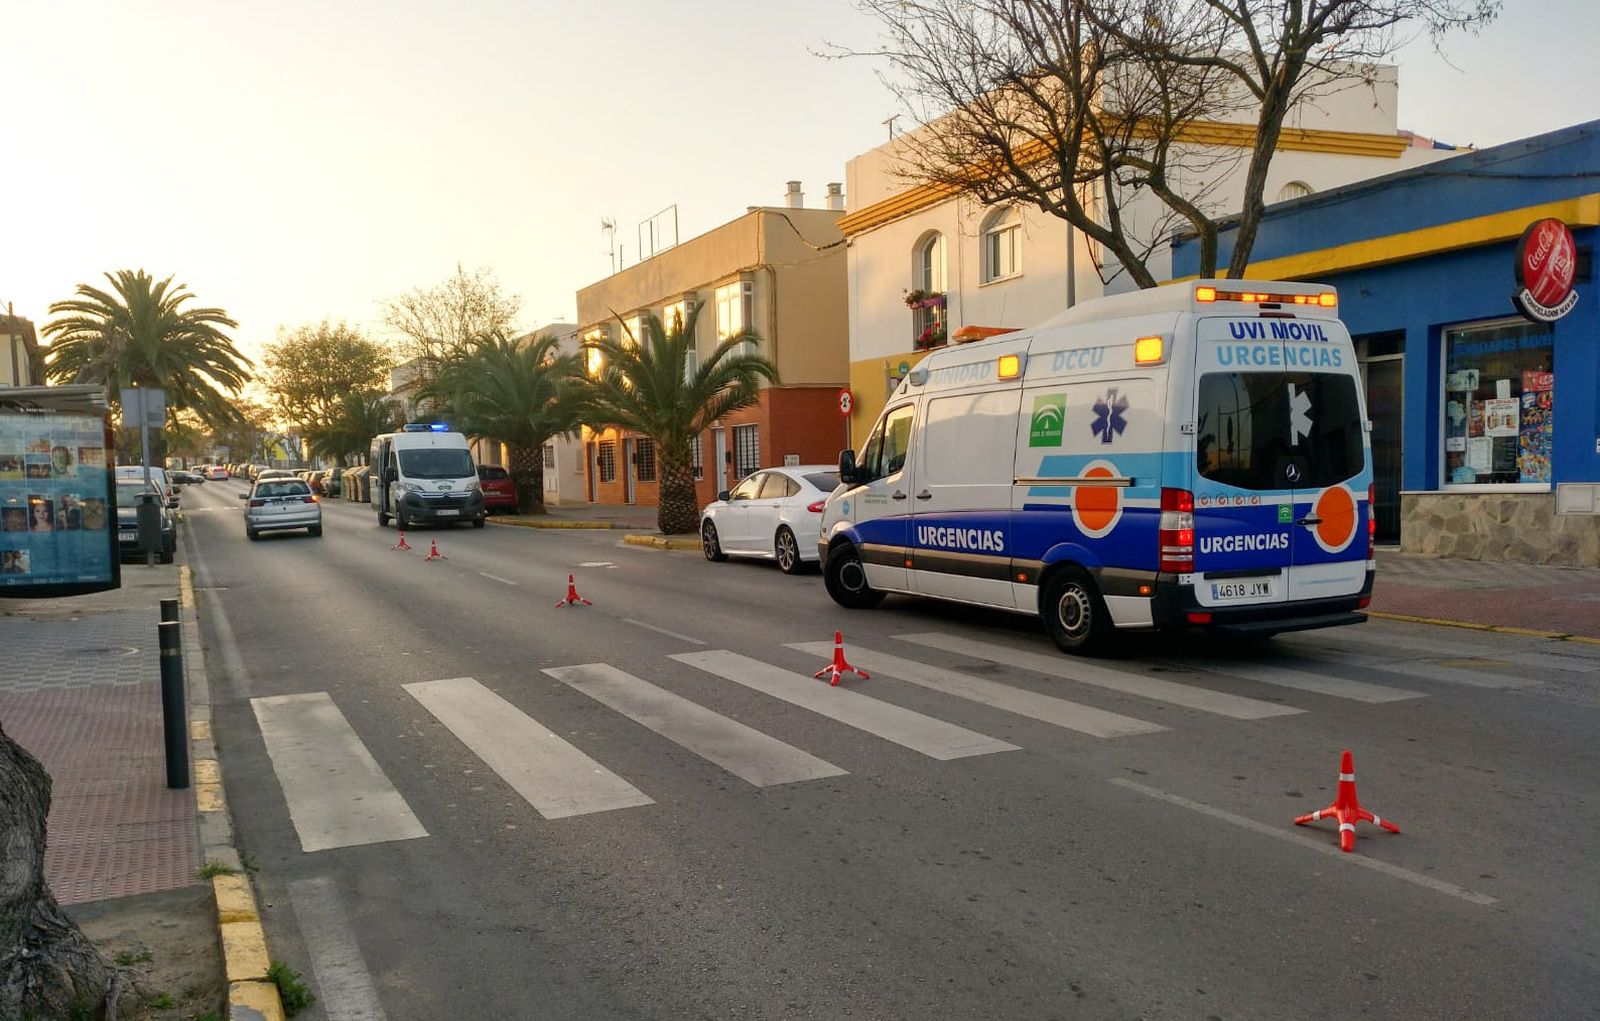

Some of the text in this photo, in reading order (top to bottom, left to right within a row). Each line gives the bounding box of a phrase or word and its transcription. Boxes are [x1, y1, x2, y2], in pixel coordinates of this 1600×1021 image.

[1229, 321, 1328, 342] UVI MOVIL
[1052, 346, 1105, 371] DCCU
[1217, 345, 1342, 367] URGENCIAS
[918, 526, 1004, 552] URGENCIAS
[1200, 533, 1289, 553] URGENCIAS
[1220, 582, 1269, 597] 4618 JYW
